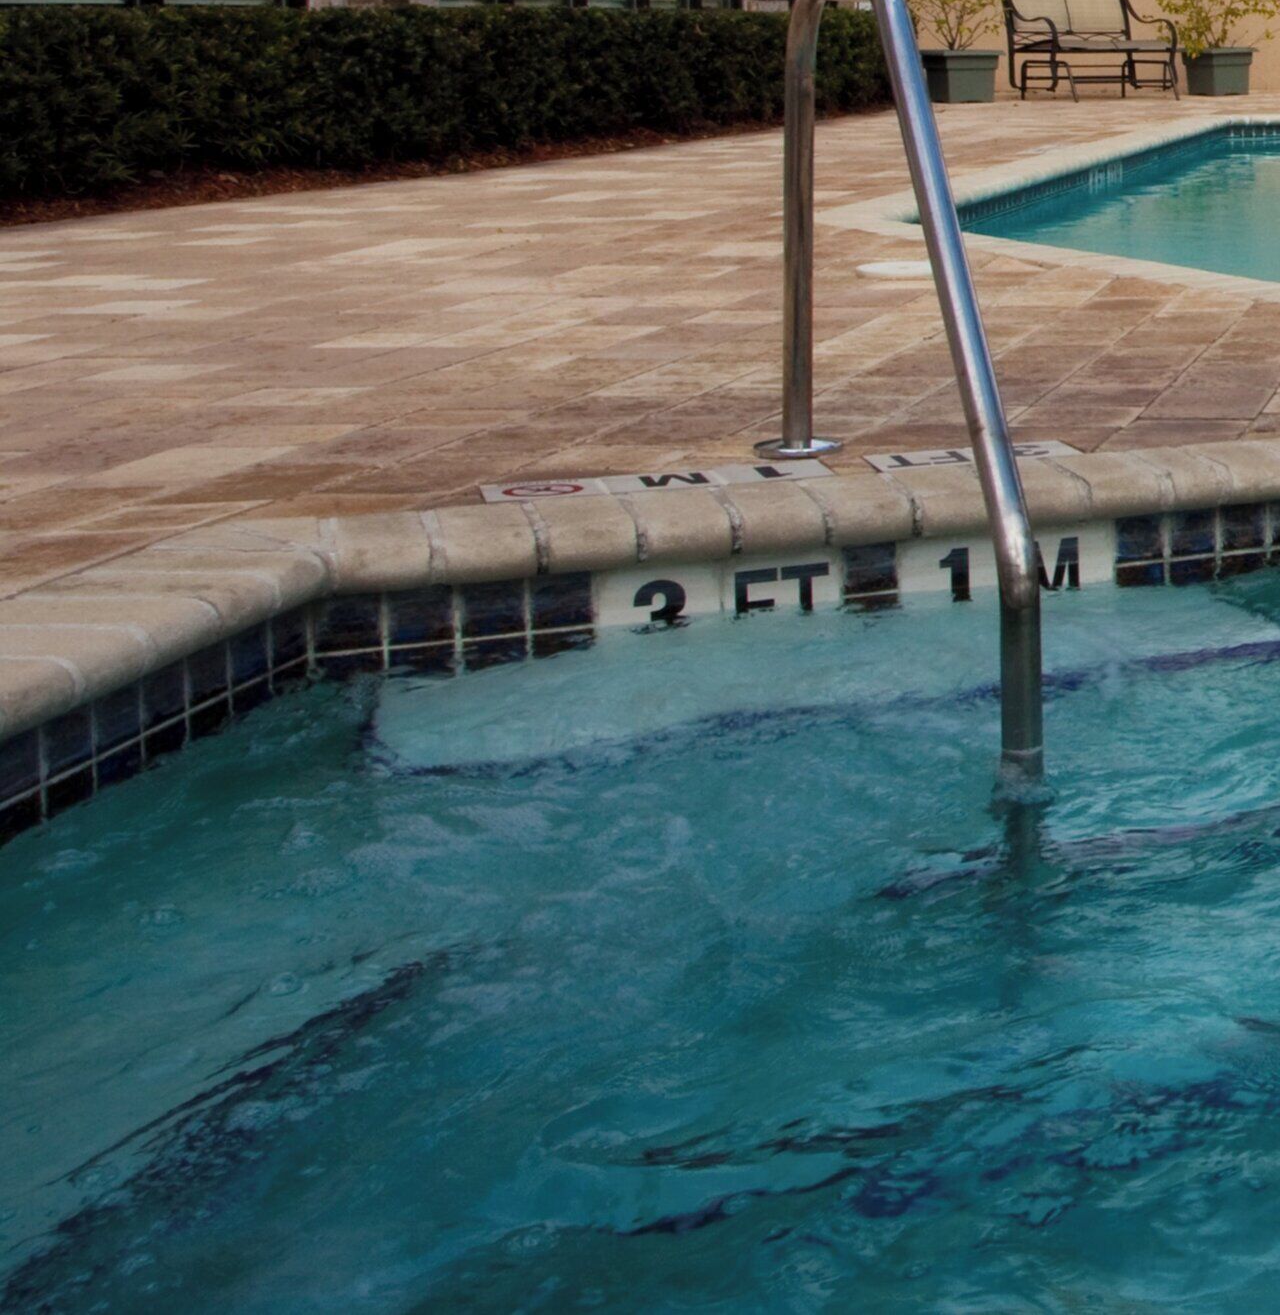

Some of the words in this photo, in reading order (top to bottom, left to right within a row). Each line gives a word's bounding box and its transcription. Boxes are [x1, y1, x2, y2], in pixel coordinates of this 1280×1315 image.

[887, 450, 971, 468] FT
[638, 471, 710, 488] M
[753, 465, 793, 480] 1
[633, 578, 688, 626] 3
[734, 561, 831, 613] FT
[938, 546, 972, 602] 1
[1035, 536, 1080, 592] M
